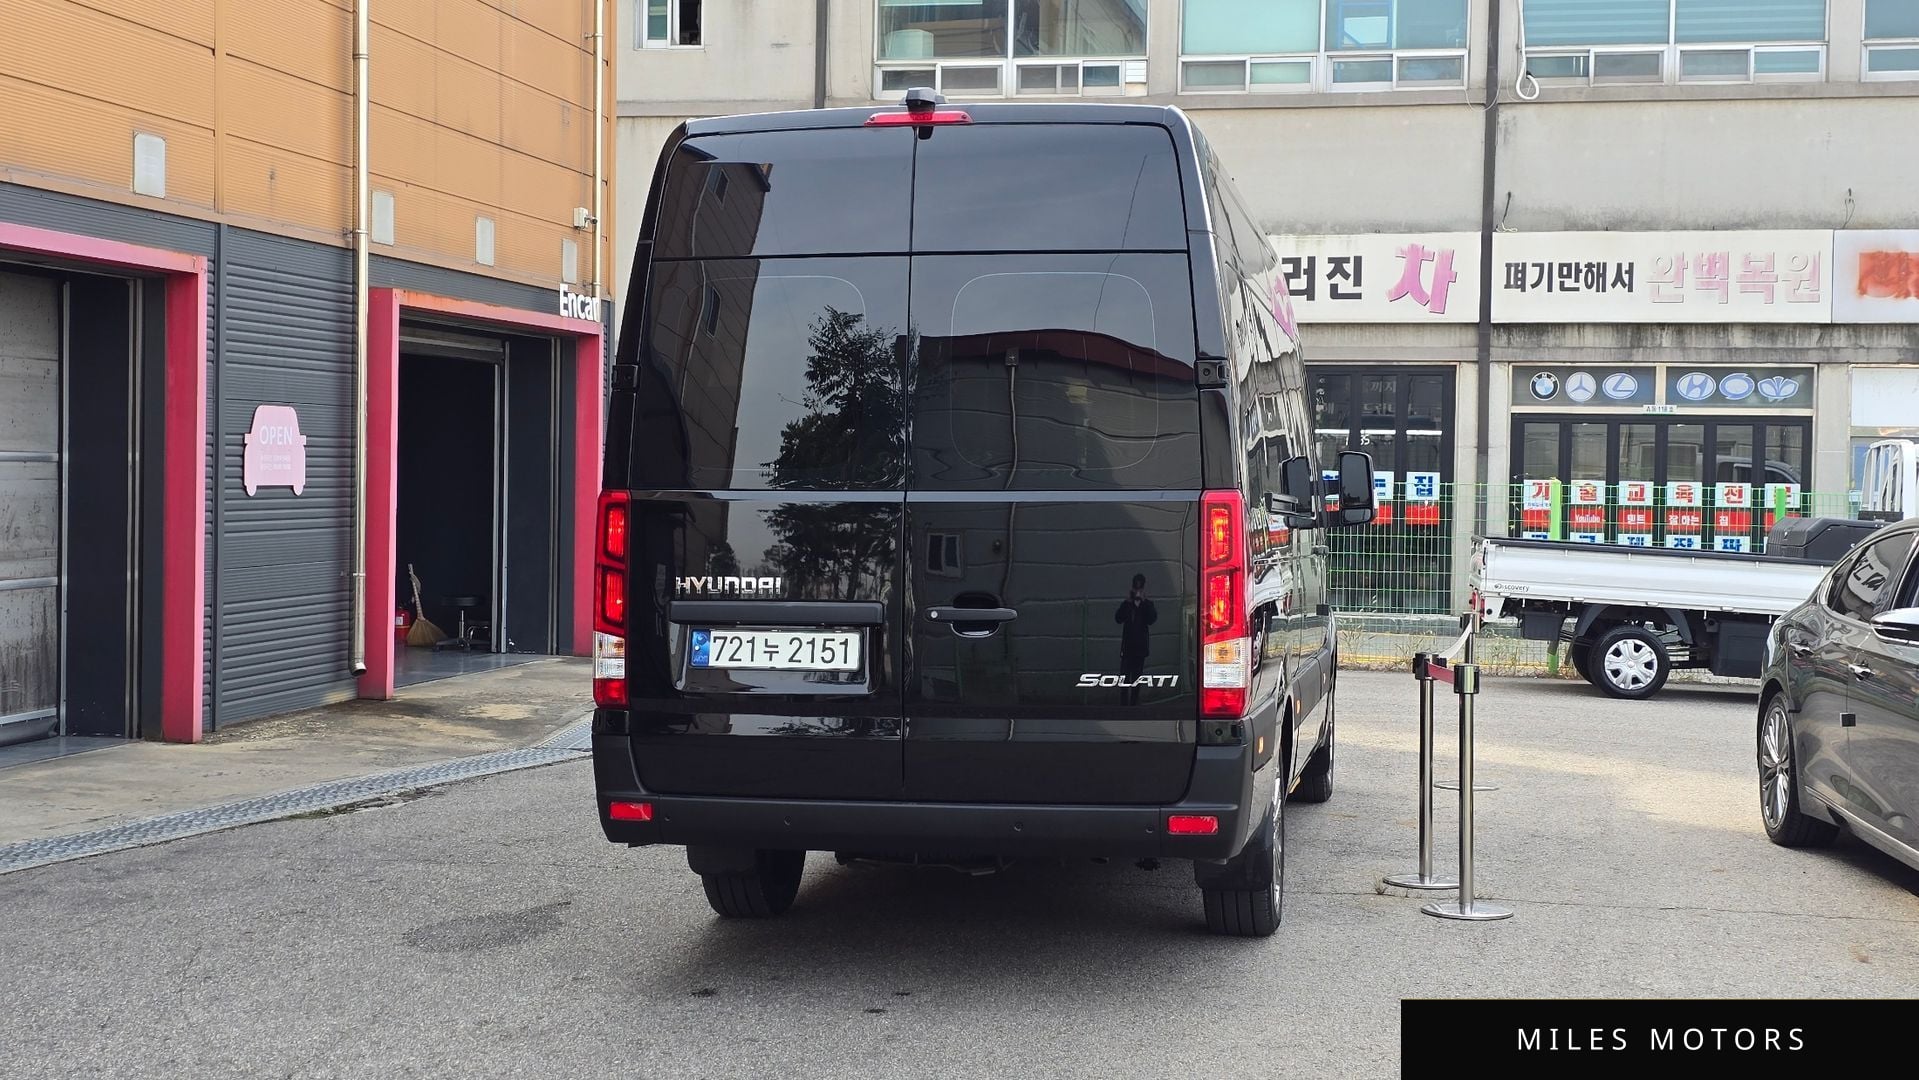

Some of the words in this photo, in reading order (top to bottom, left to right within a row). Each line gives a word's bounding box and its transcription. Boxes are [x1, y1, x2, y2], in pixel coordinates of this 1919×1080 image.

[1385, 243, 1458, 314] 차
[1503, 261, 1635, 293] 펴기만해서
[1646, 250, 1822, 305] 완벽복원
[560, 283, 601, 323] Encar
[260, 425, 293, 446] OPEN
[1574, 514, 1601, 523] YouTube
[675, 576, 782, 595] HYUNDAI
[1075, 673, 1179, 688] SOLATI
